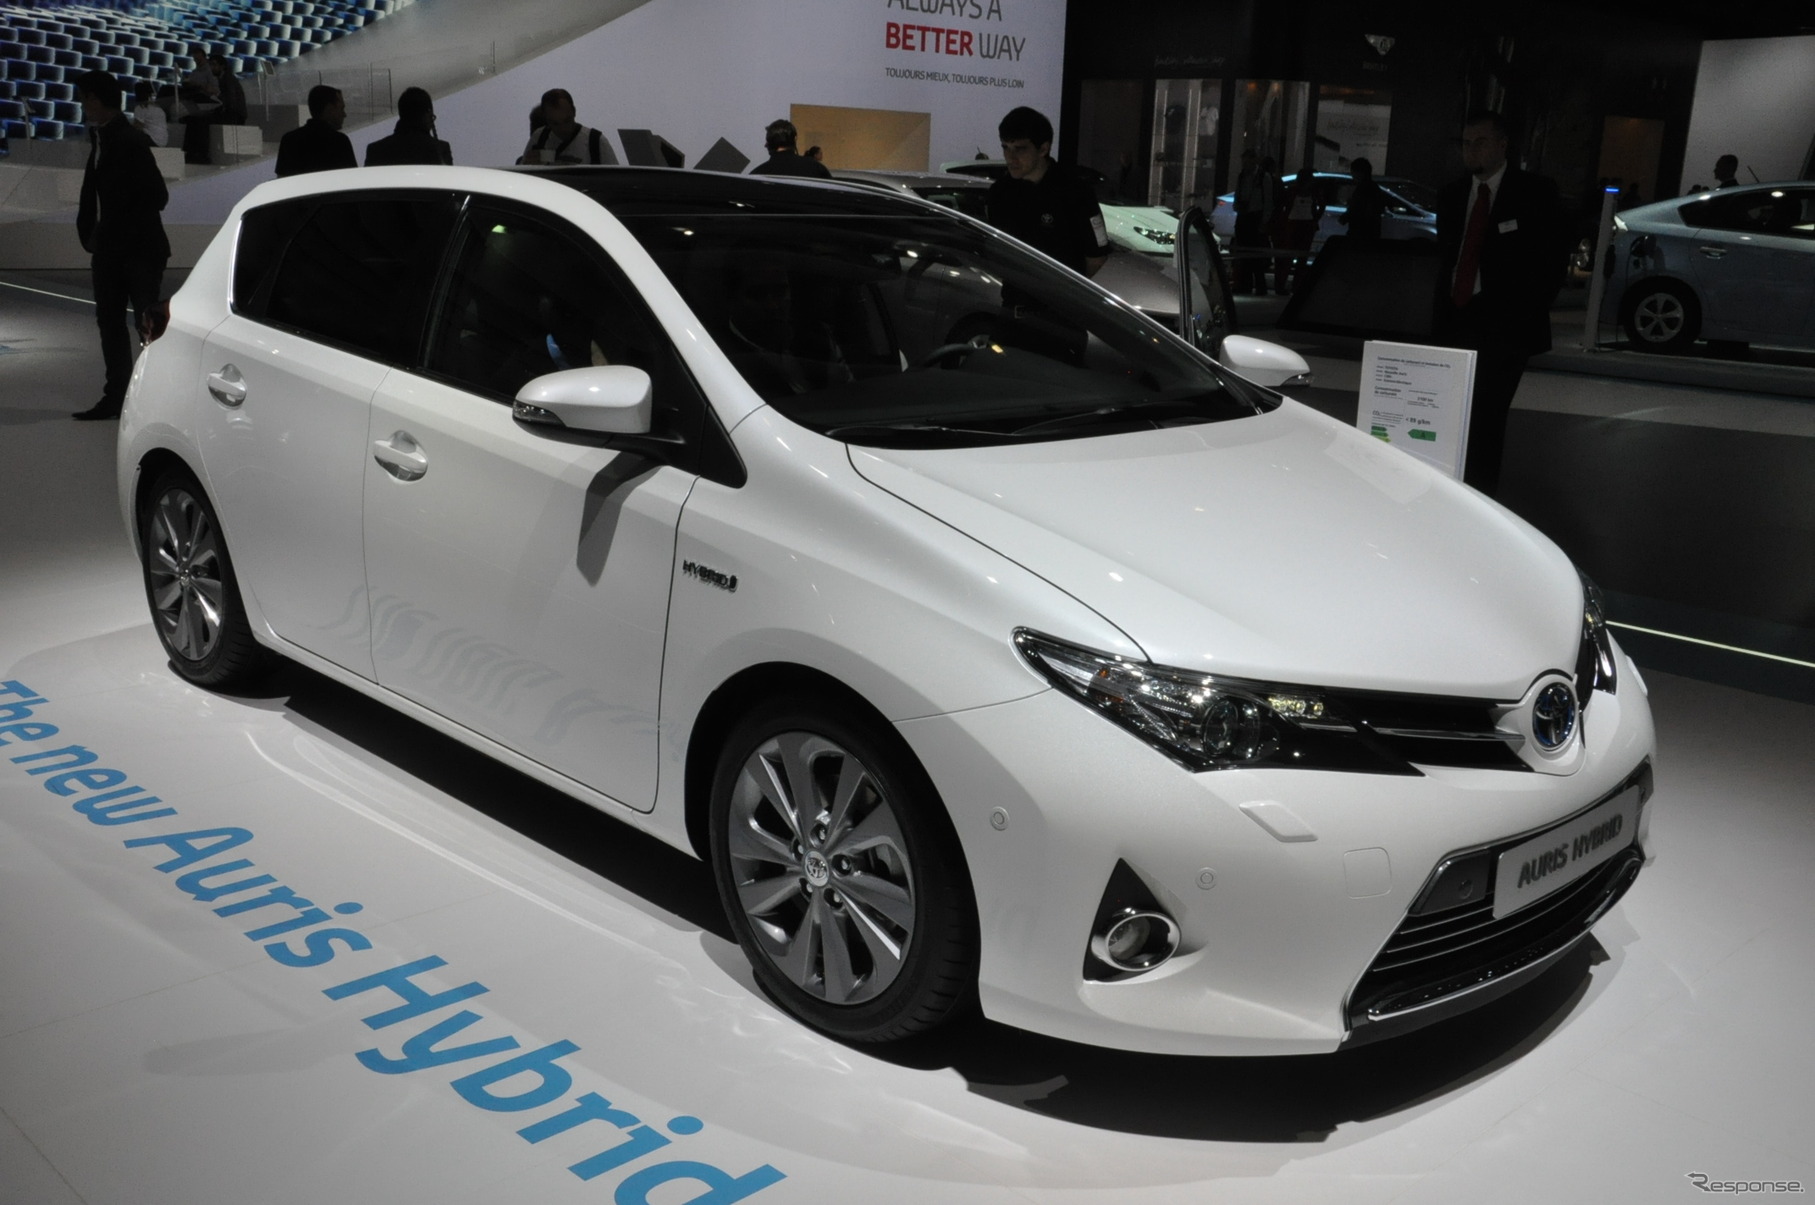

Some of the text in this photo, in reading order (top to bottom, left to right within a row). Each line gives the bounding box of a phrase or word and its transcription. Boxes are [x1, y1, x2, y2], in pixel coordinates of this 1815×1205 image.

[987, 0, 1002, 22] A
[885, 21, 1026, 61] BETTER WAY
[885, 67, 1025, 89] TOUJOURS MIEUX, TOUJOURS PLUS LOIN
[1517, 814, 1623, 889] AURIS HYBRID
[9, 744, 178, 826] new
[123, 826, 373, 968] Auris
[321, 954, 788, 1205] Hybrid
